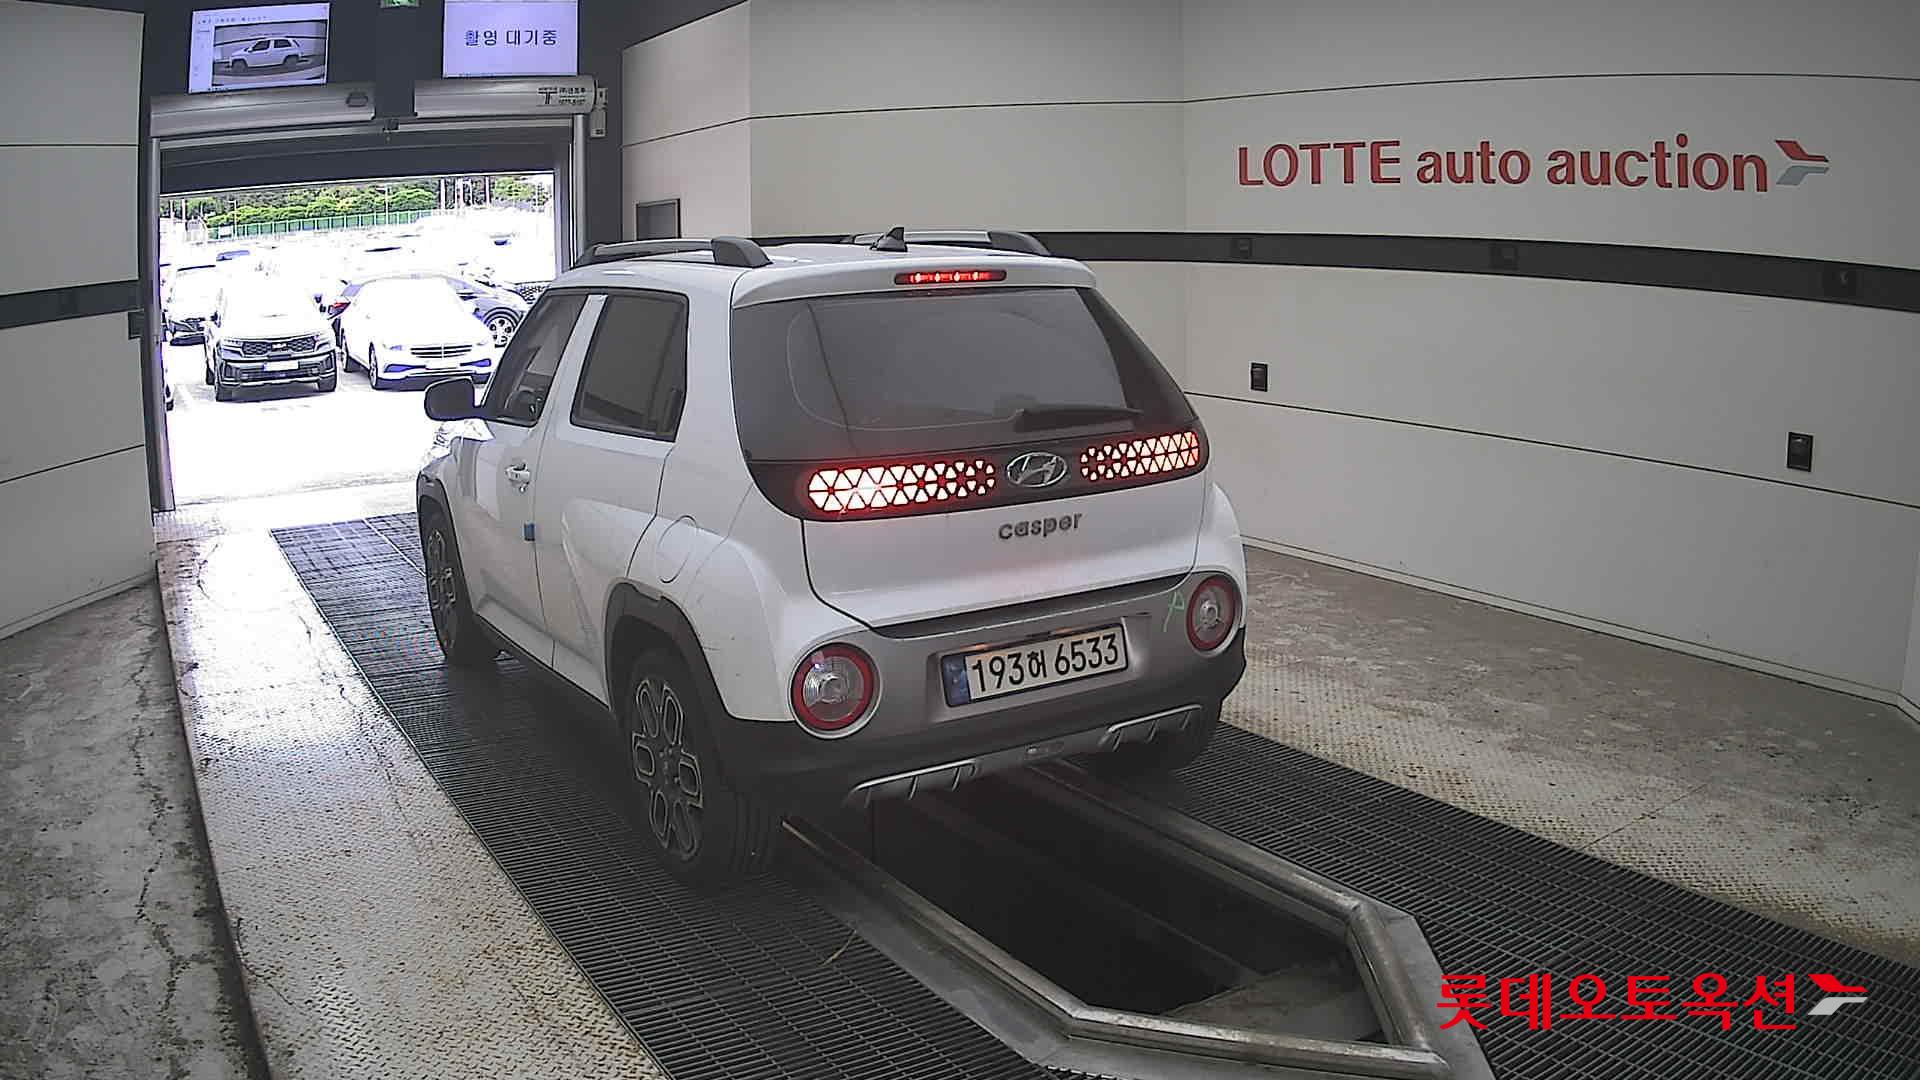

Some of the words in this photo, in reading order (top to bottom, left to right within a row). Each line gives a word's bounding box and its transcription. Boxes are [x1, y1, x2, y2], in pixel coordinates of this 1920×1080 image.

[506, 29, 557, 46] 대기중
[1238, 140, 1401, 187] LOTTE
[1416, 141, 1531, 185] auto
[1546, 133, 1768, 193] auction
[999, 513, 1083, 540] casper
[971, 649, 1048, 693] 193허
[1054, 633, 1119, 676] 6533
